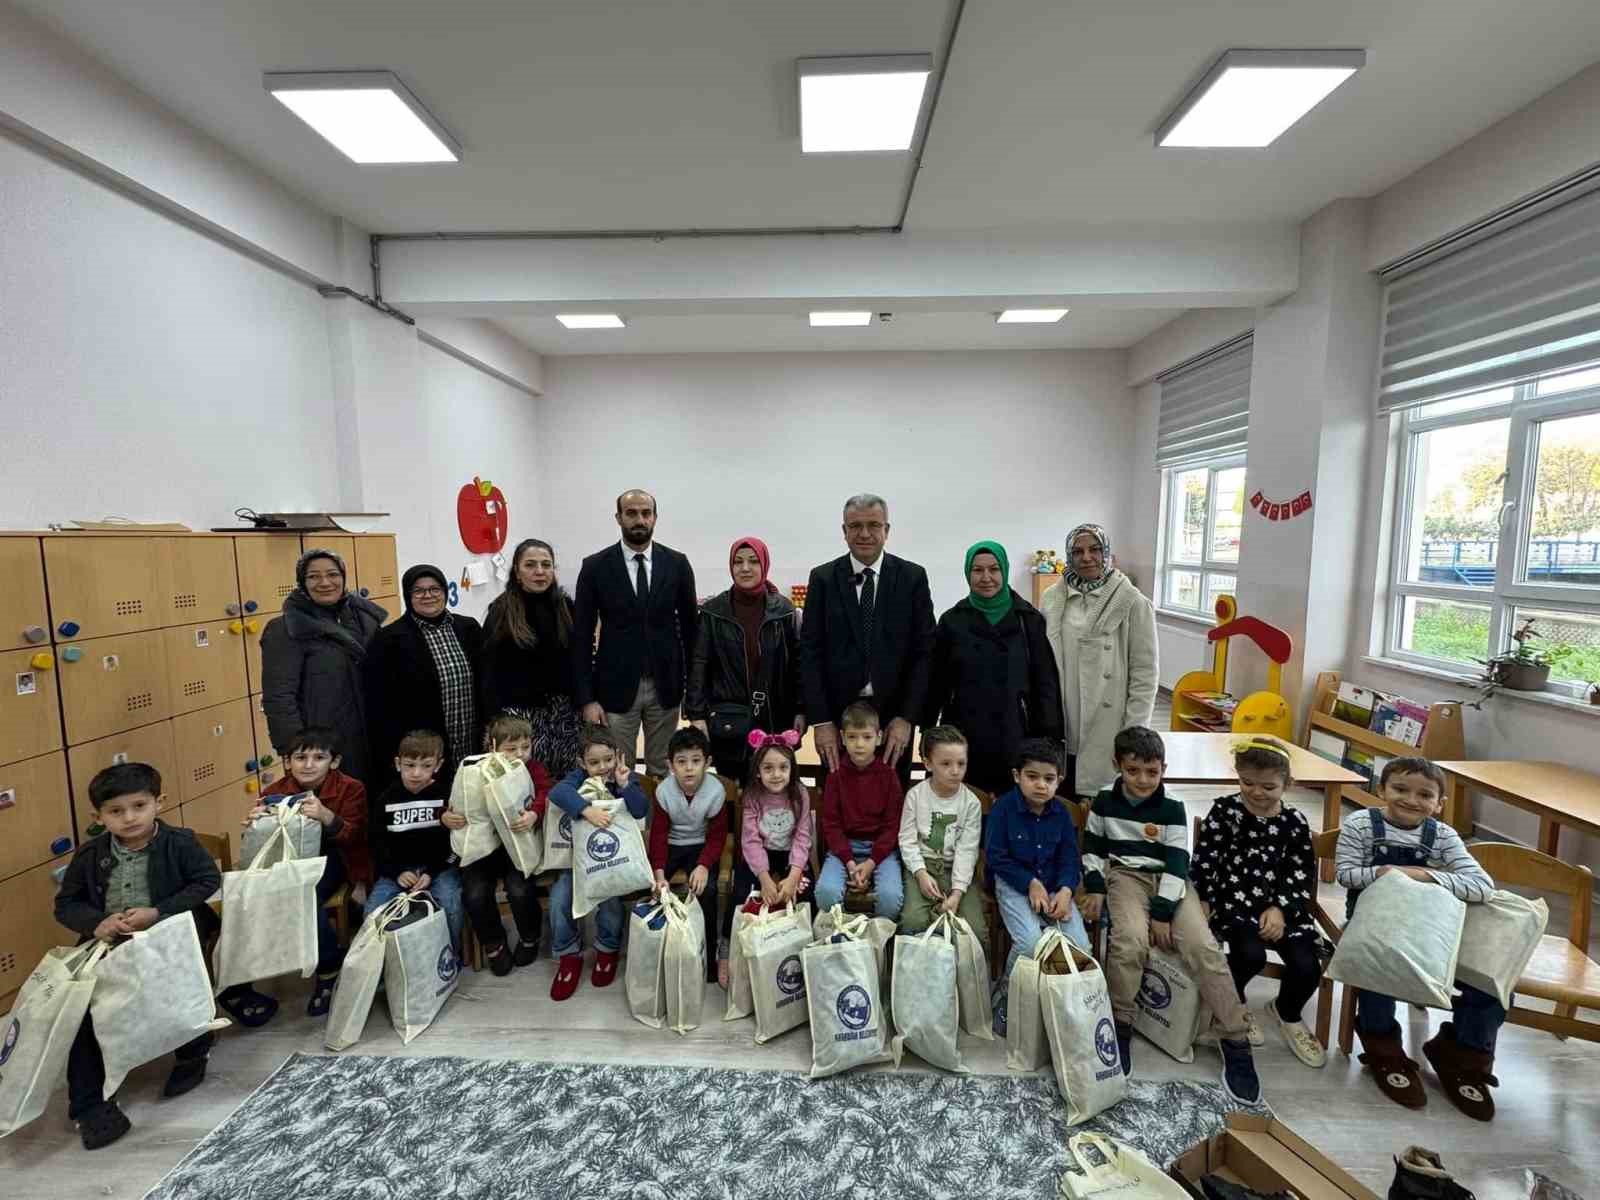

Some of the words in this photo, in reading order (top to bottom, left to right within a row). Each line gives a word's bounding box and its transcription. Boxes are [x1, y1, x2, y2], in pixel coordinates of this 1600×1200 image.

[461, 566, 471, 592] 4
[448, 581, 459, 608] 3
[393, 808, 434, 825] SUPER
